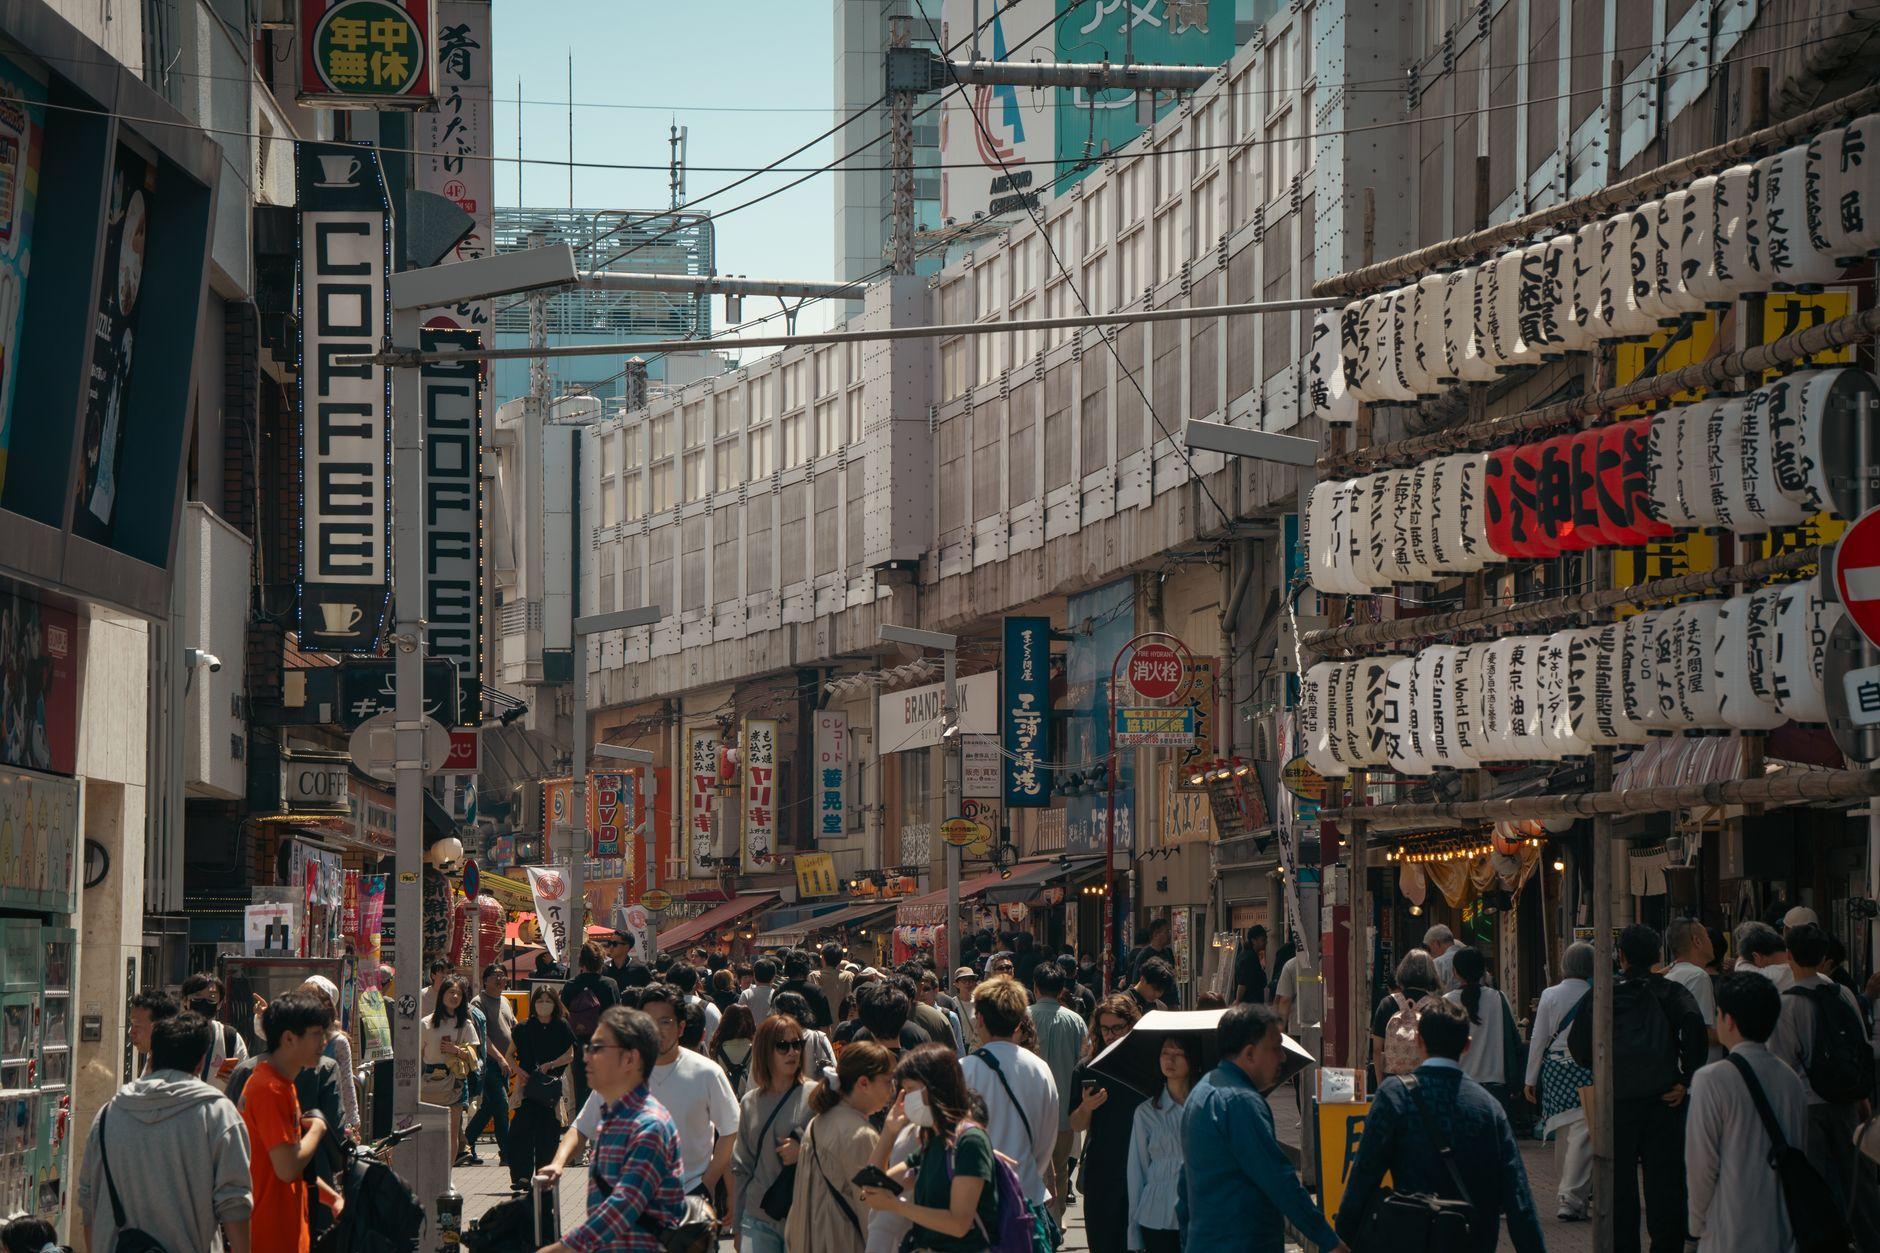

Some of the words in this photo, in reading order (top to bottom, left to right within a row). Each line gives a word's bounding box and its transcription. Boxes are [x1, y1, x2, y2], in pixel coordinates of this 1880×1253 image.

[330, 17, 407, 51] 年中
[330, 51, 408, 86] 無休
[446, 185, 463, 197] 4F
[315, 222, 373, 576] COFFEE
[427, 384, 472, 672] COFFEE
[1020, 629, 1034, 681] まぐろ問屋
[1133, 661, 1179, 682] 消火栓
[1455, 648, 1472, 674] The
[1455, 677, 1470, 717] World
[1509, 644, 1527, 736] 東京油組
[749, 730, 760, 763] 煮込み
[761, 731, 773, 764] もつ焼
[834, 719, 842, 762] レコード
[1457, 720, 1472, 748] End
[705, 740, 717, 772] もつ焼
[749, 767, 773, 826] ヤリキ
[599, 790, 618, 843] DVD
